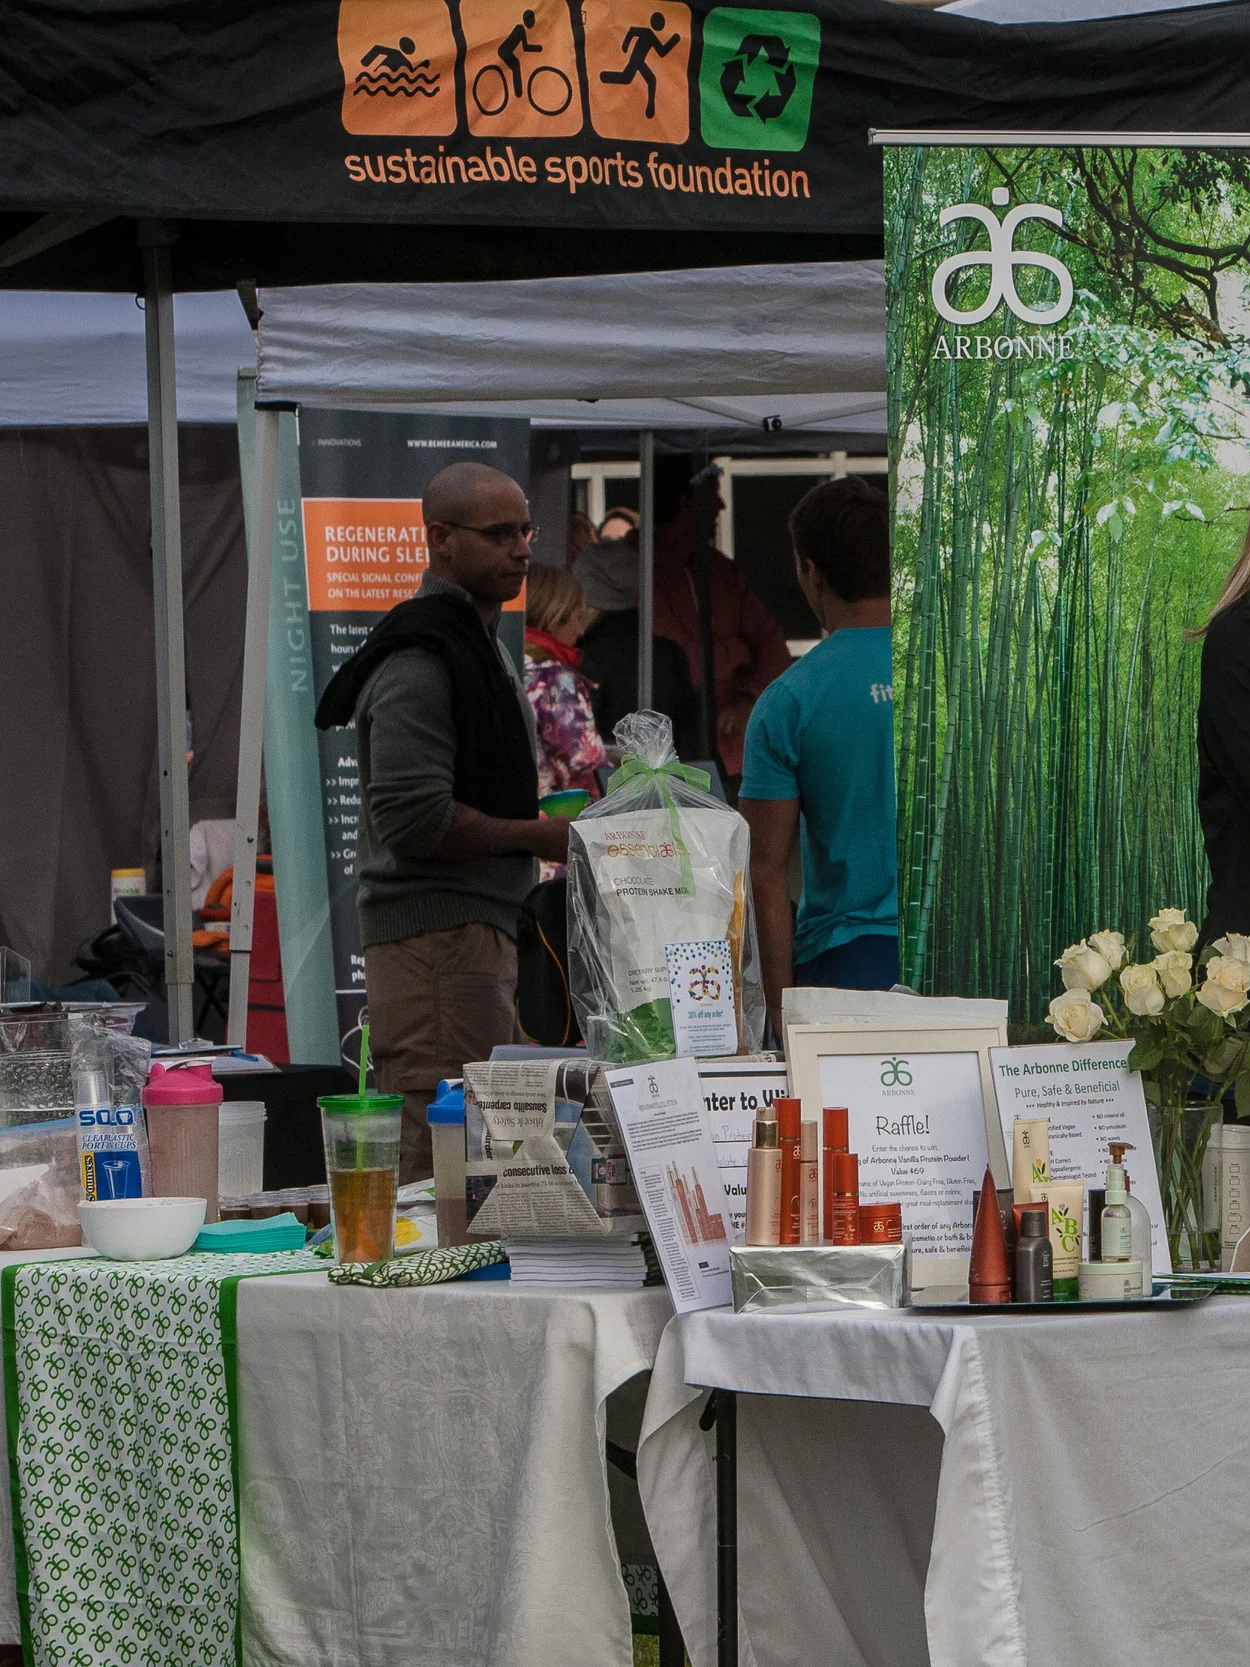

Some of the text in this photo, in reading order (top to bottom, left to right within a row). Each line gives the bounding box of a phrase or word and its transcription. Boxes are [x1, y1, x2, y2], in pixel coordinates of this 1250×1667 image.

[345, 144, 810, 198] sustainable sports foundation
[932, 335, 1074, 360] ARBONNE
[326, 547, 390, 563] DURING
[327, 573, 392, 583] SPECIAL SIGNAL
[277, 500, 308, 692] NIGHT USE
[328, 588, 391, 599] ON THE LATEST
[330, 624, 347, 635] The
[604, 830, 646, 841] ARBONNE
[614, 877, 654, 886] CHOCOLATE
[616, 887, 649, 896] PROTEIN
[649, 887, 673, 896] SHAKE
[999, 1059, 1127, 1077] The Arbonne Difference
[1015, 1080, 1120, 1098] Pure, Safe & Beneficial
[513, 1101, 547, 1113] Sausalito
[740, 1092, 757, 1111] to
[79, 1110, 133, 1126] SOLO
[876, 1115, 930, 1135] Raffle!
[871, 1156, 897, 1164] Arbonne
[85, 1156, 95, 1193] ounces
[503, 1164, 567, 1177] consecutive loss
[724, 1184, 747, 1196] Valu
[940, 1223, 951, 1231] any
[945, 1233, 958, 1241] bath
